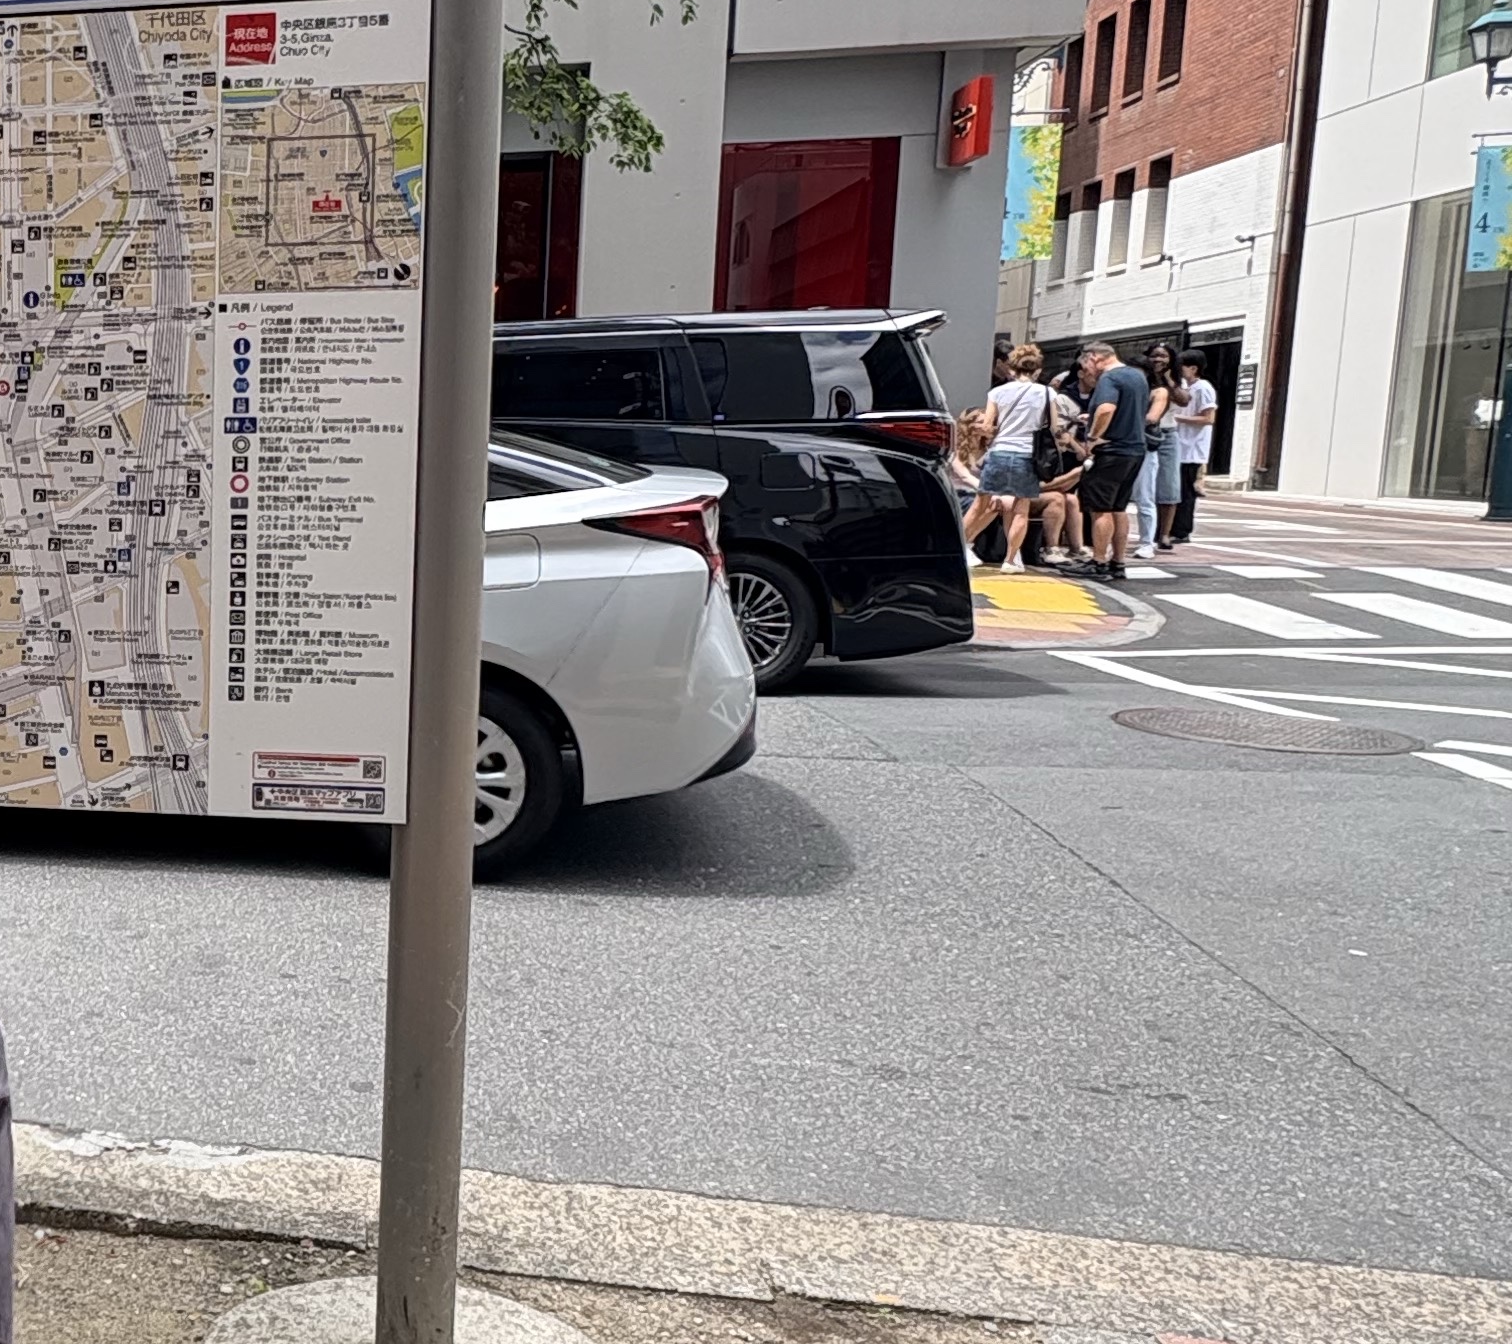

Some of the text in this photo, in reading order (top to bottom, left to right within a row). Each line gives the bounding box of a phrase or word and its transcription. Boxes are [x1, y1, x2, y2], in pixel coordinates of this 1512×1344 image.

[144, 10, 207, 28] 千代田区
[138, 27, 213, 46] Chiyoda City
[233, 27, 269, 40] 現在地
[228, 42, 273, 54] Address
[279, 45, 309, 58] Chuo
[260, 302, 294, 315] Legend
